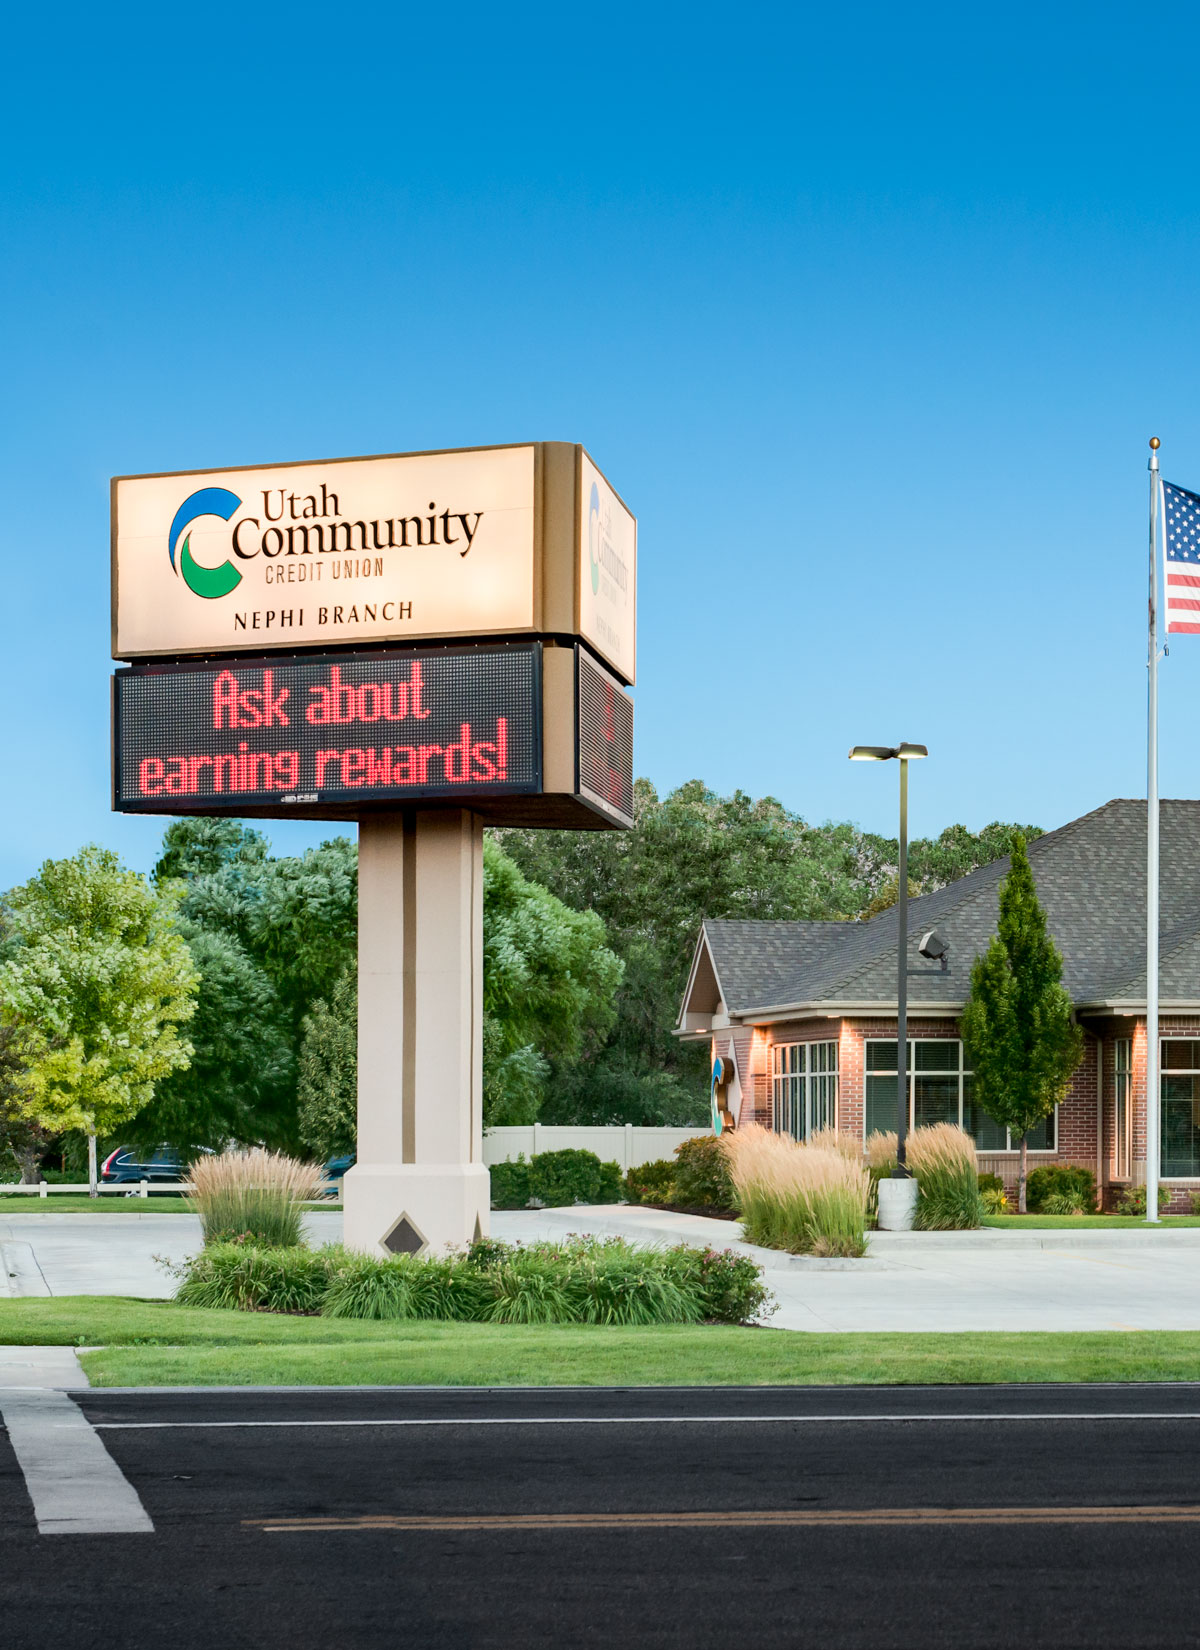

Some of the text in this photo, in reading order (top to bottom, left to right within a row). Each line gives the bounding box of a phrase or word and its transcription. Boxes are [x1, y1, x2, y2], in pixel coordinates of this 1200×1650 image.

[261, 482, 343, 521] Utah
[231, 501, 485, 559] Community
[265, 557, 384, 585] CREDIT UNION
[234, 601, 413, 631] NEPHI BRANCH
[212, 661, 431, 730] Ask about
[138, 717, 508, 795] earning rewards!
